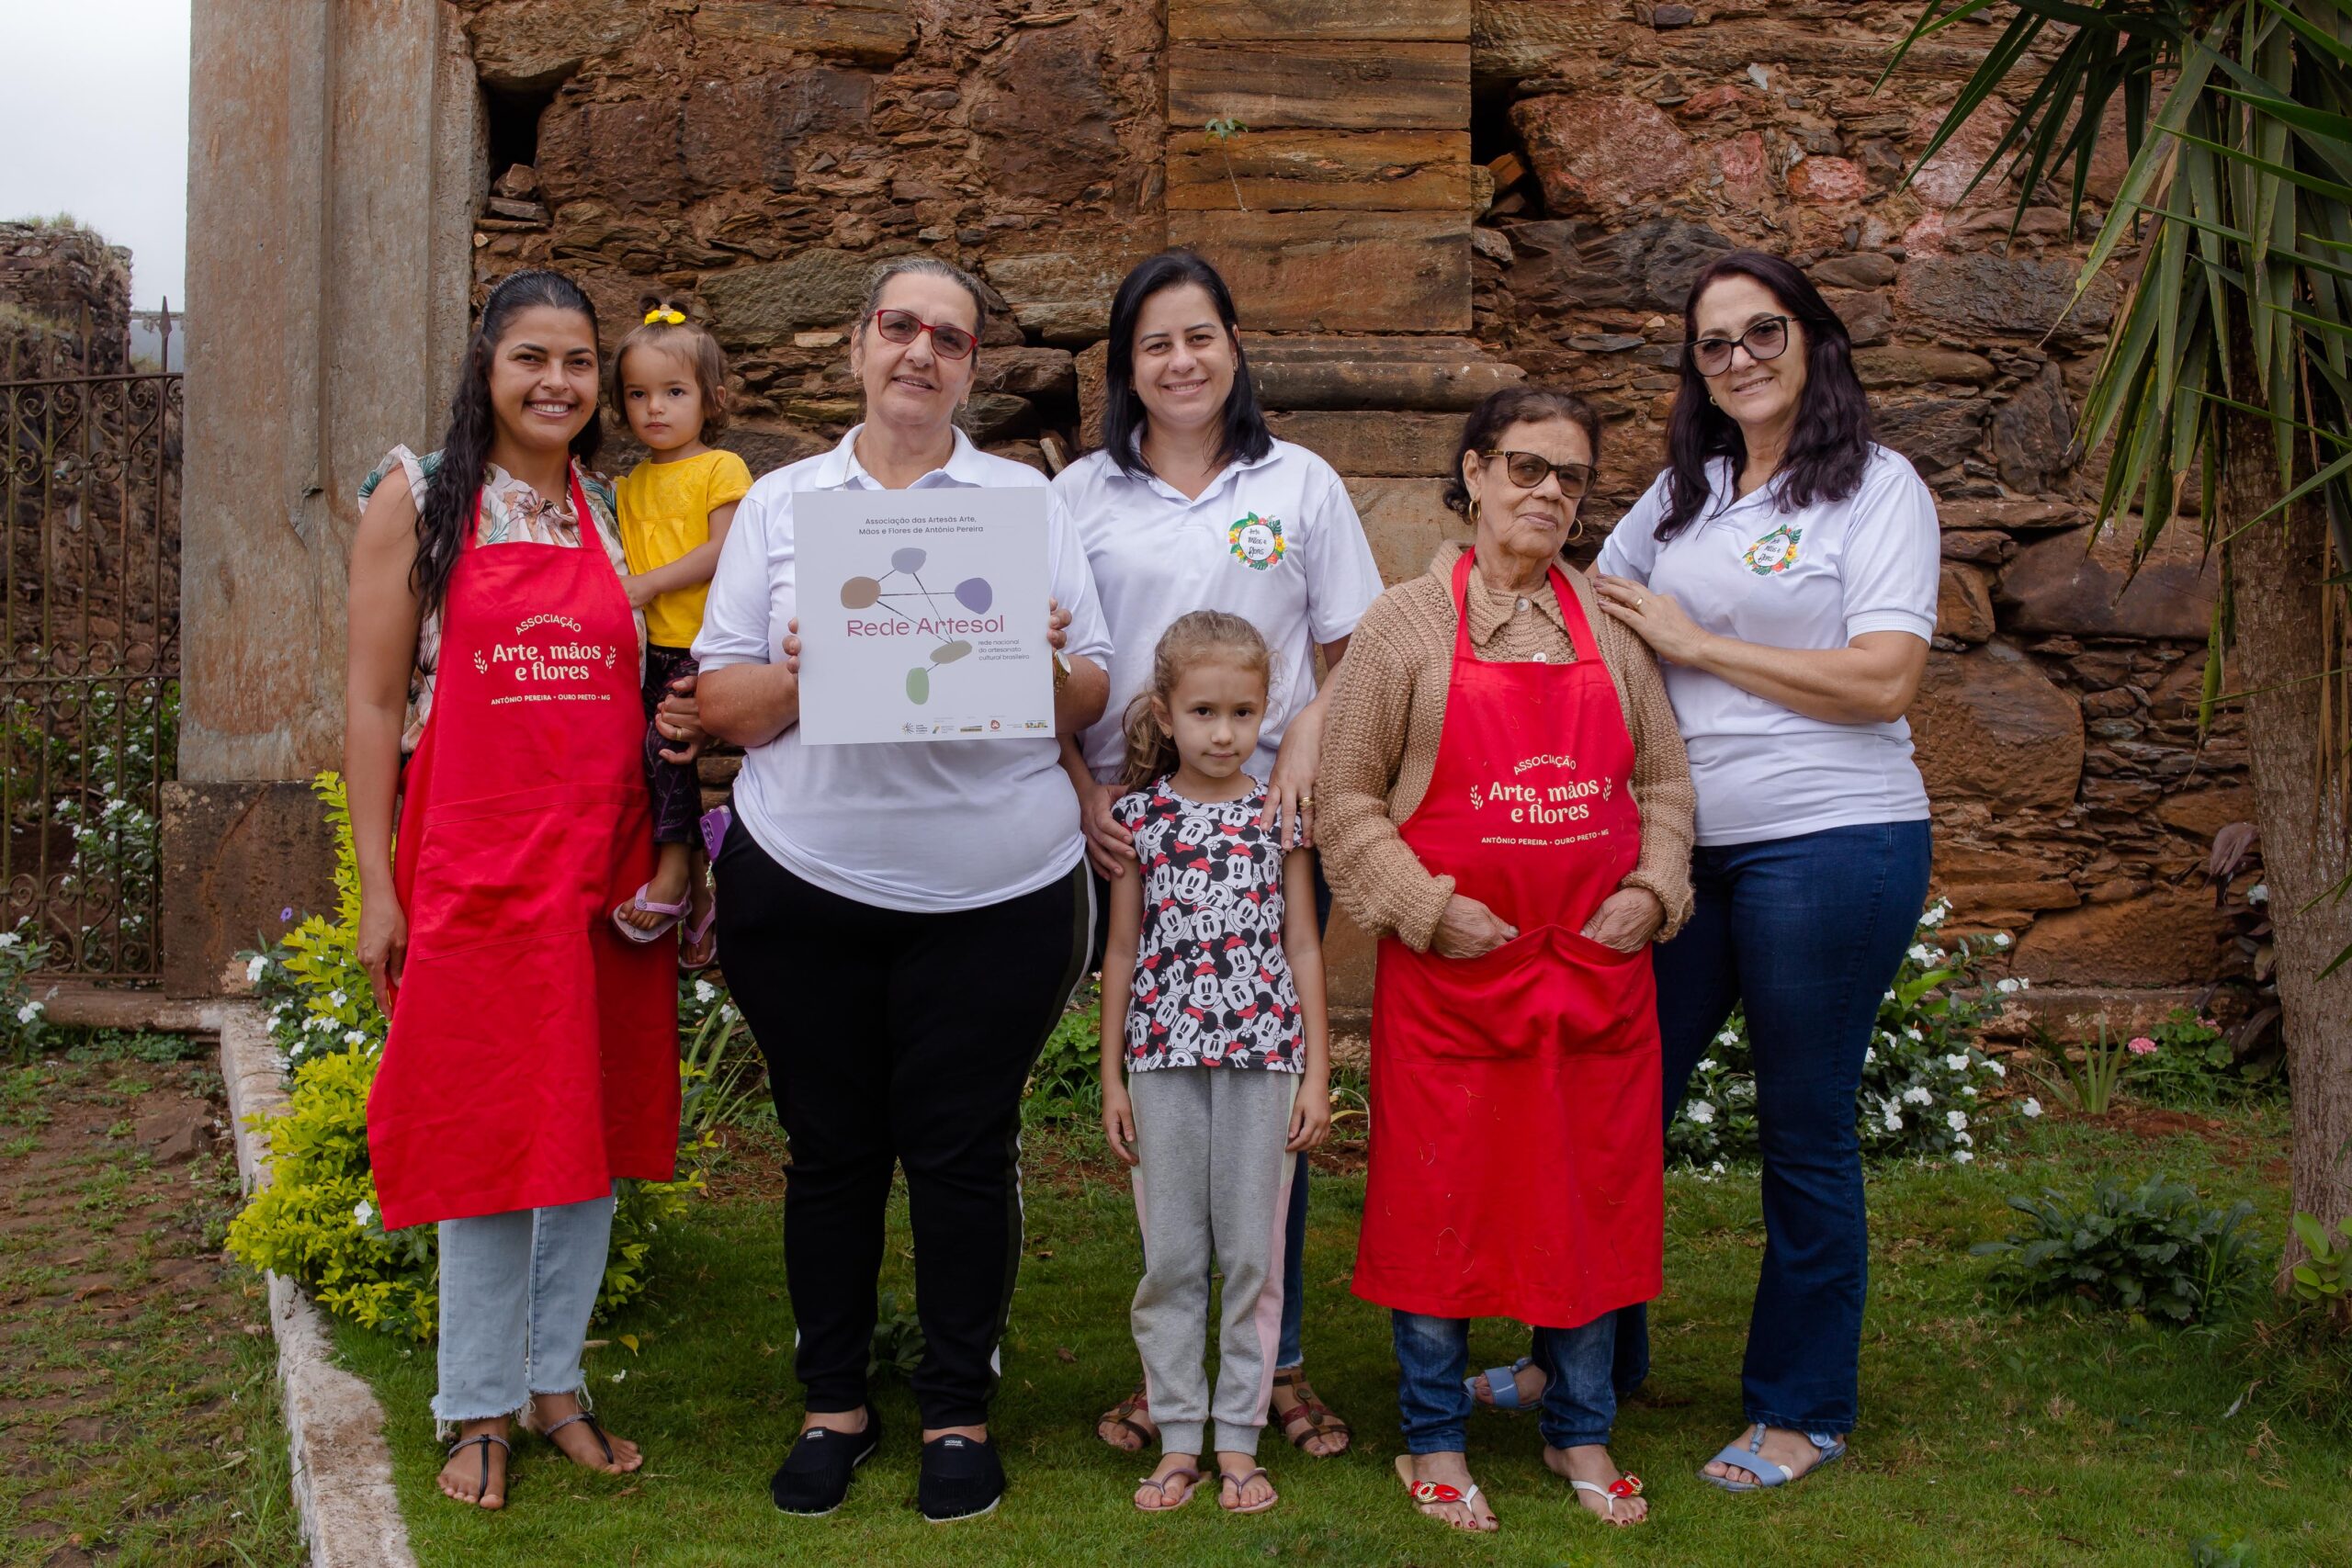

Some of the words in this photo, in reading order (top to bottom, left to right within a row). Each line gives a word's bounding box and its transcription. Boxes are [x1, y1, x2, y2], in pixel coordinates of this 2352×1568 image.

[865, 516, 910, 526] Associação
[928, 515, 957, 524] Artesãs
[959, 515, 977, 524] Arte,
[515, 614, 582, 636] ASSOCIAÇÃO
[847, 618, 910, 637] Rede
[916, 615, 1004, 636] Artesol
[492, 644, 545, 662] Arte,
[549, 642, 602, 660] mãos
[514, 668, 527, 682] e
[532, 660, 590, 681] flores
[491, 695, 523, 705] ANTÔNIO
[525, 694, 551, 702] PEREIRA
[1513, 754, 1577, 775] ASSOCIAÇÃO
[1488, 782, 1543, 804] Arte,
[1548, 780, 1600, 802] mãos
[1510, 807, 1523, 823] e
[1529, 804, 1589, 824] flores
[1481, 836, 1516, 844] ANTÔNIO
[1518, 838, 1548, 846] PEREIRA
[1555, 836, 1576, 846] OURO
[1577, 832, 1598, 841] PRETO
